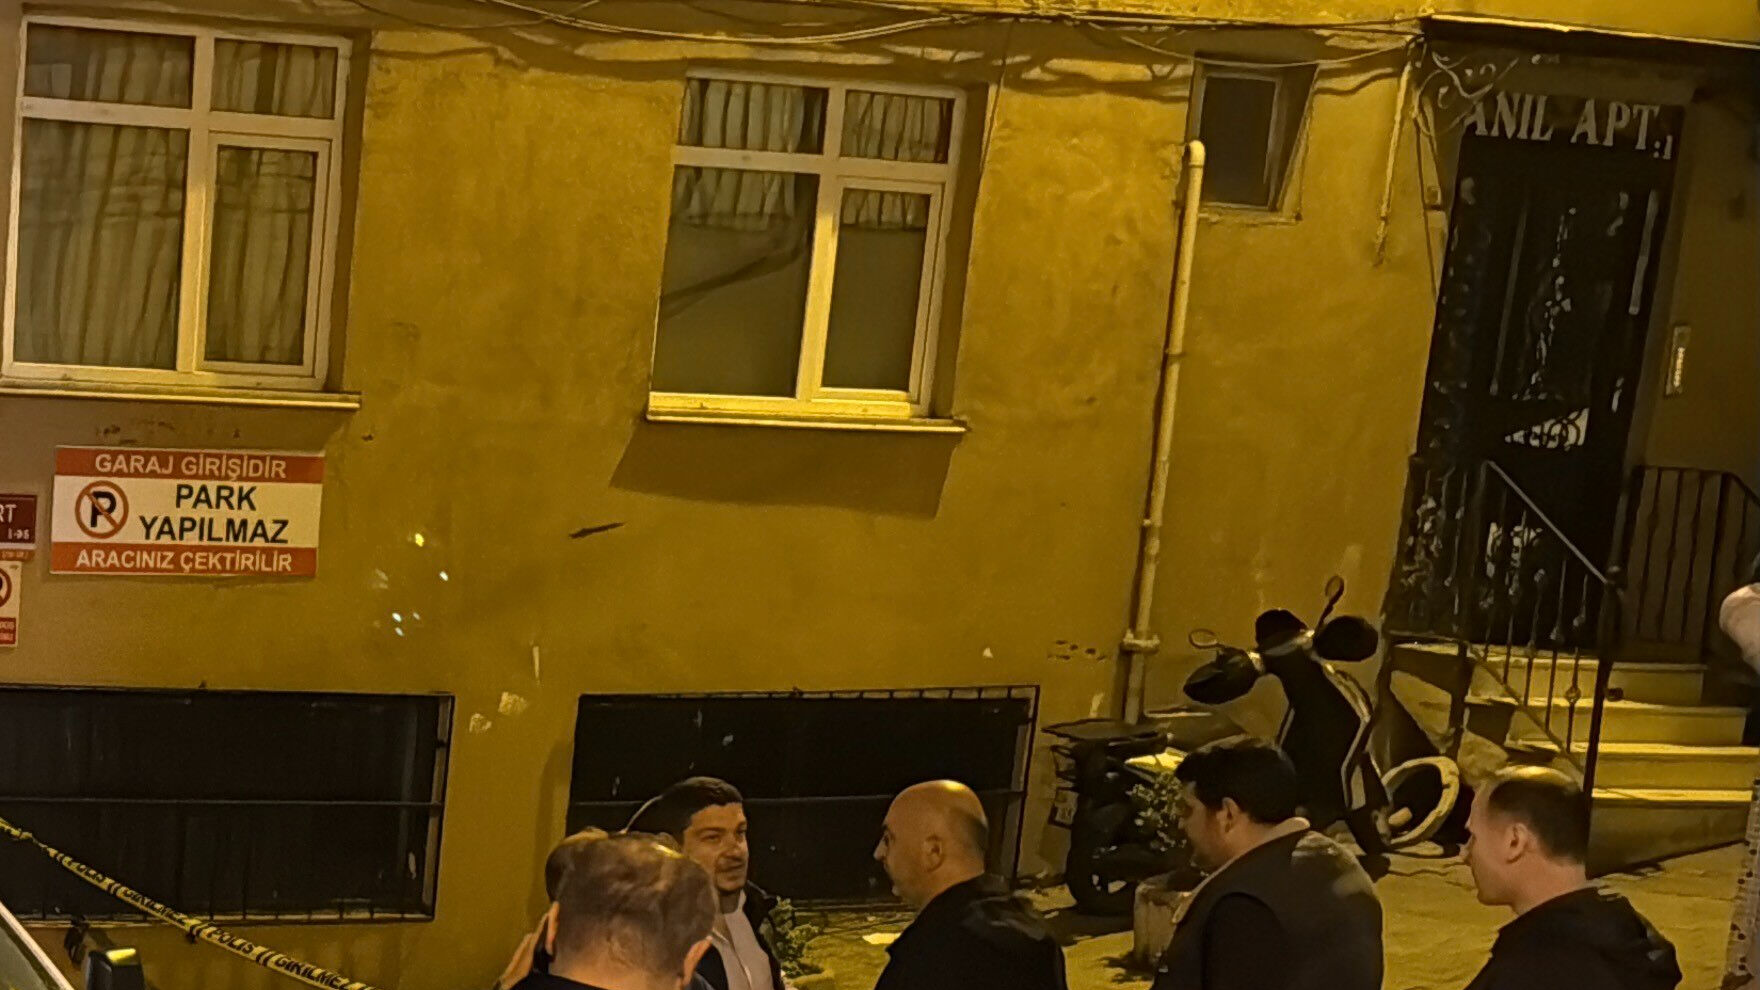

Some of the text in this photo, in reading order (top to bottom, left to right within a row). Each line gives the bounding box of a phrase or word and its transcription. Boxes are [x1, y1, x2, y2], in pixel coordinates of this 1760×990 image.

[1464, 91, 1553, 141] ANIL
[95, 453, 287, 481] GARAJ GİRİŞİDİR
[175, 484, 257, 511] PARK
[140, 515, 288, 544] YAPILMAZ
[76, 549, 174, 569] ARACINIZ
